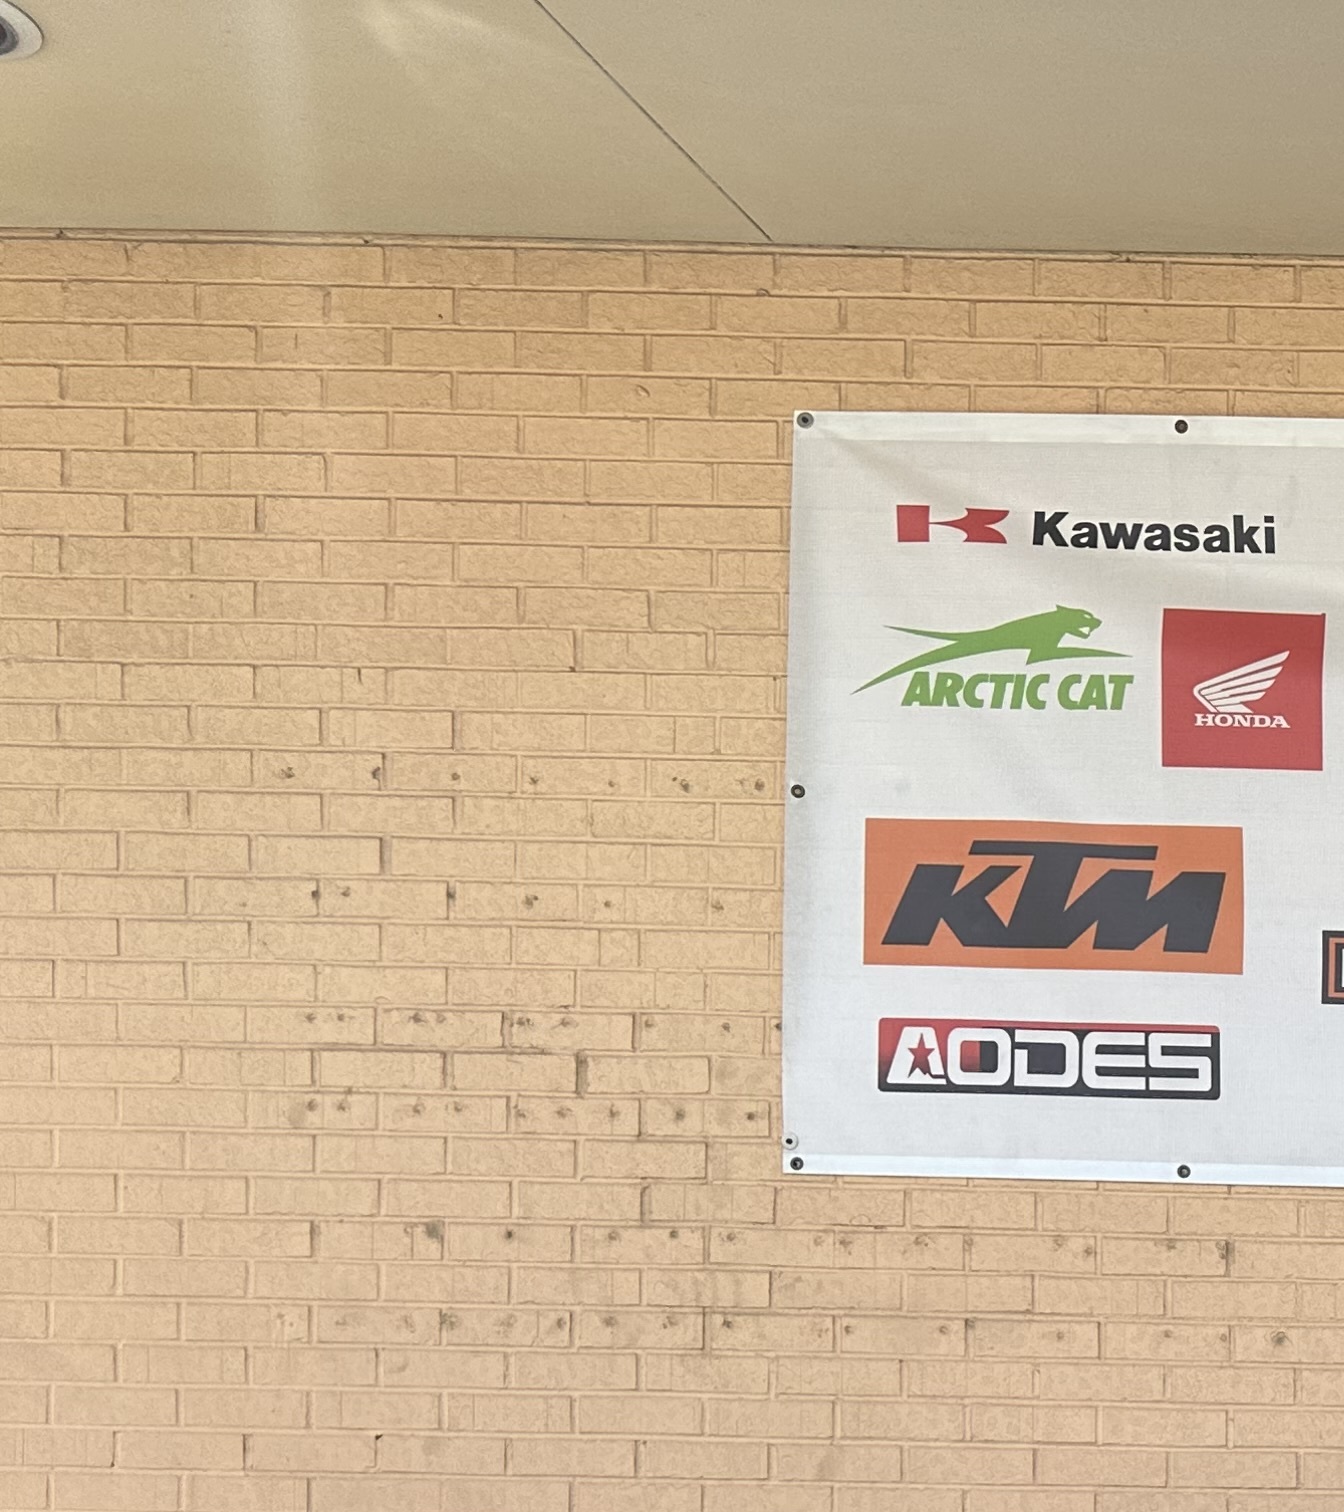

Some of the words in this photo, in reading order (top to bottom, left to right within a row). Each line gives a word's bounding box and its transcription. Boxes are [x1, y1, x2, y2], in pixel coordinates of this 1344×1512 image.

[1031, 510, 1277, 555] Kawasaki
[901, 671, 1051, 711] ARCTIC
[1056, 673, 1134, 712] CAT
[1194, 712, 1291, 730] HONDA
[880, 839, 1227, 954] KTM
[885, 1024, 1213, 1092] AODES
